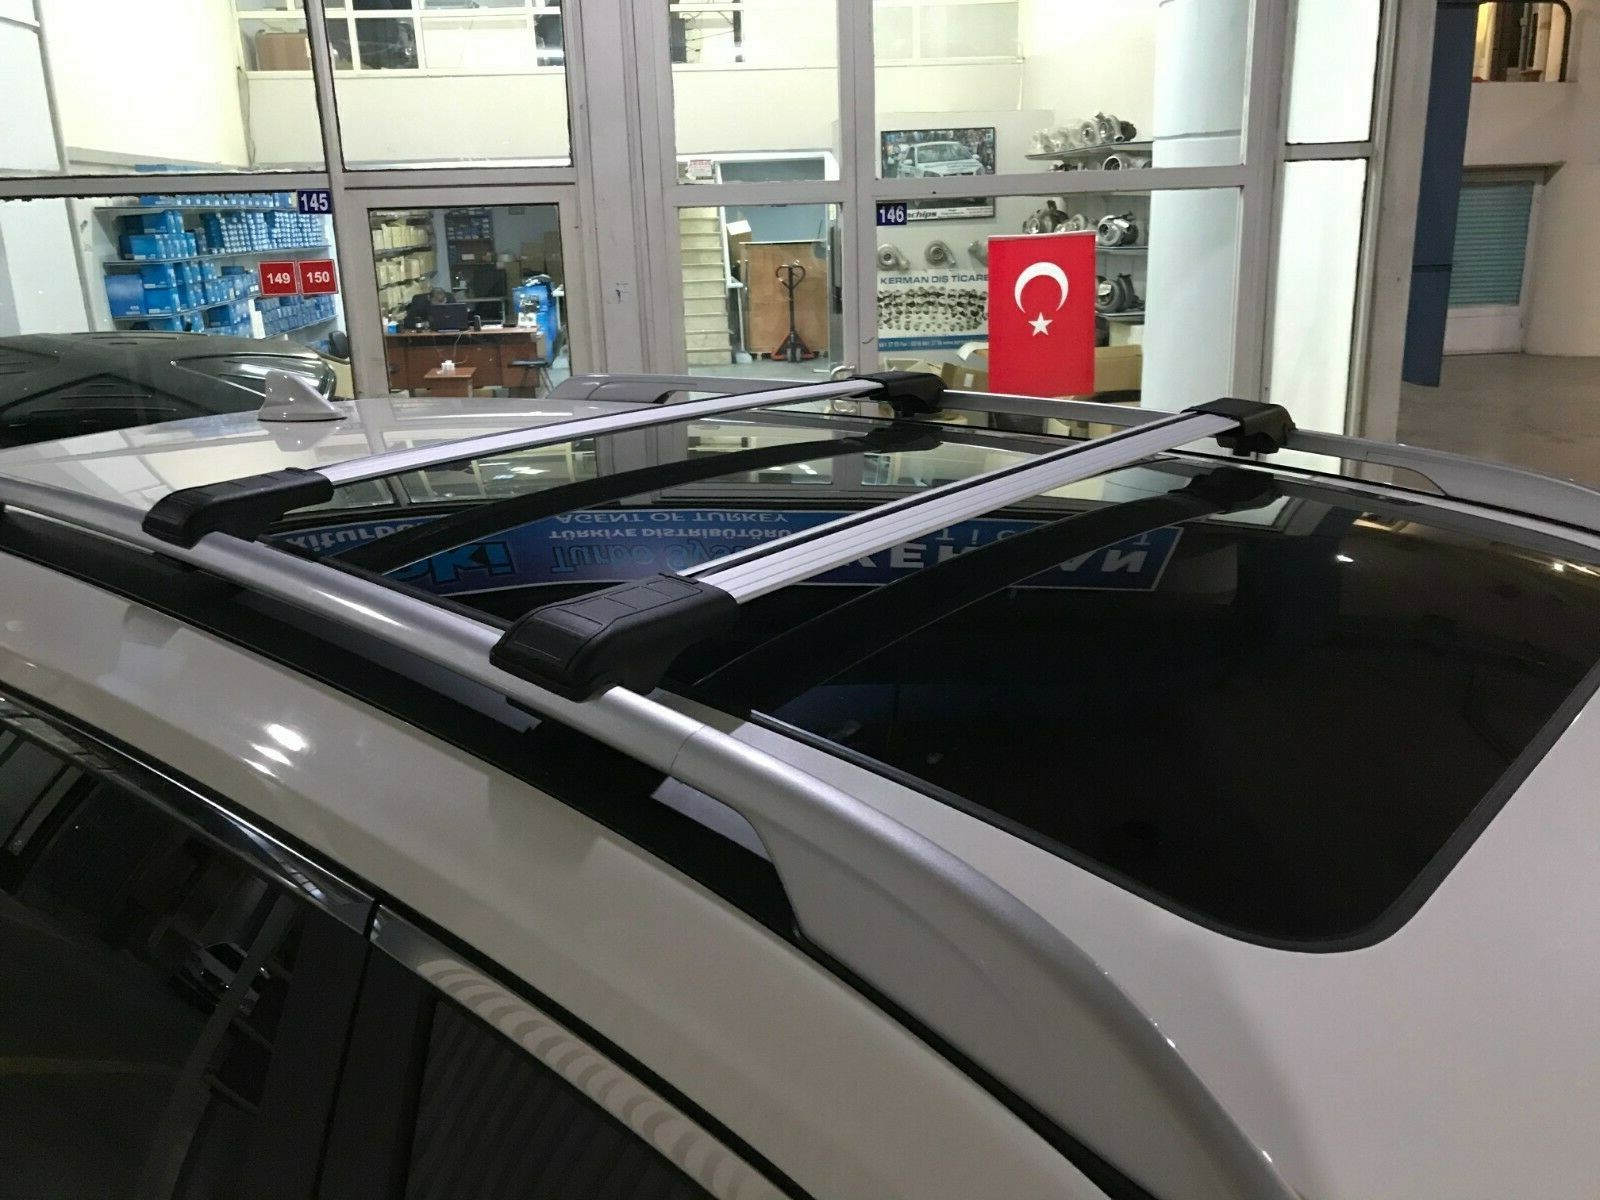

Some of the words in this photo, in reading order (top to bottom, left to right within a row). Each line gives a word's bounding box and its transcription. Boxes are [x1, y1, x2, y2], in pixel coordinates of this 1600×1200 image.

[301, 193, 328, 211] 145
[880, 206, 904, 223] 146
[267, 272, 291, 284] 149
[307, 271, 330, 284] 150
[880, 276, 929, 285] KERMAN
